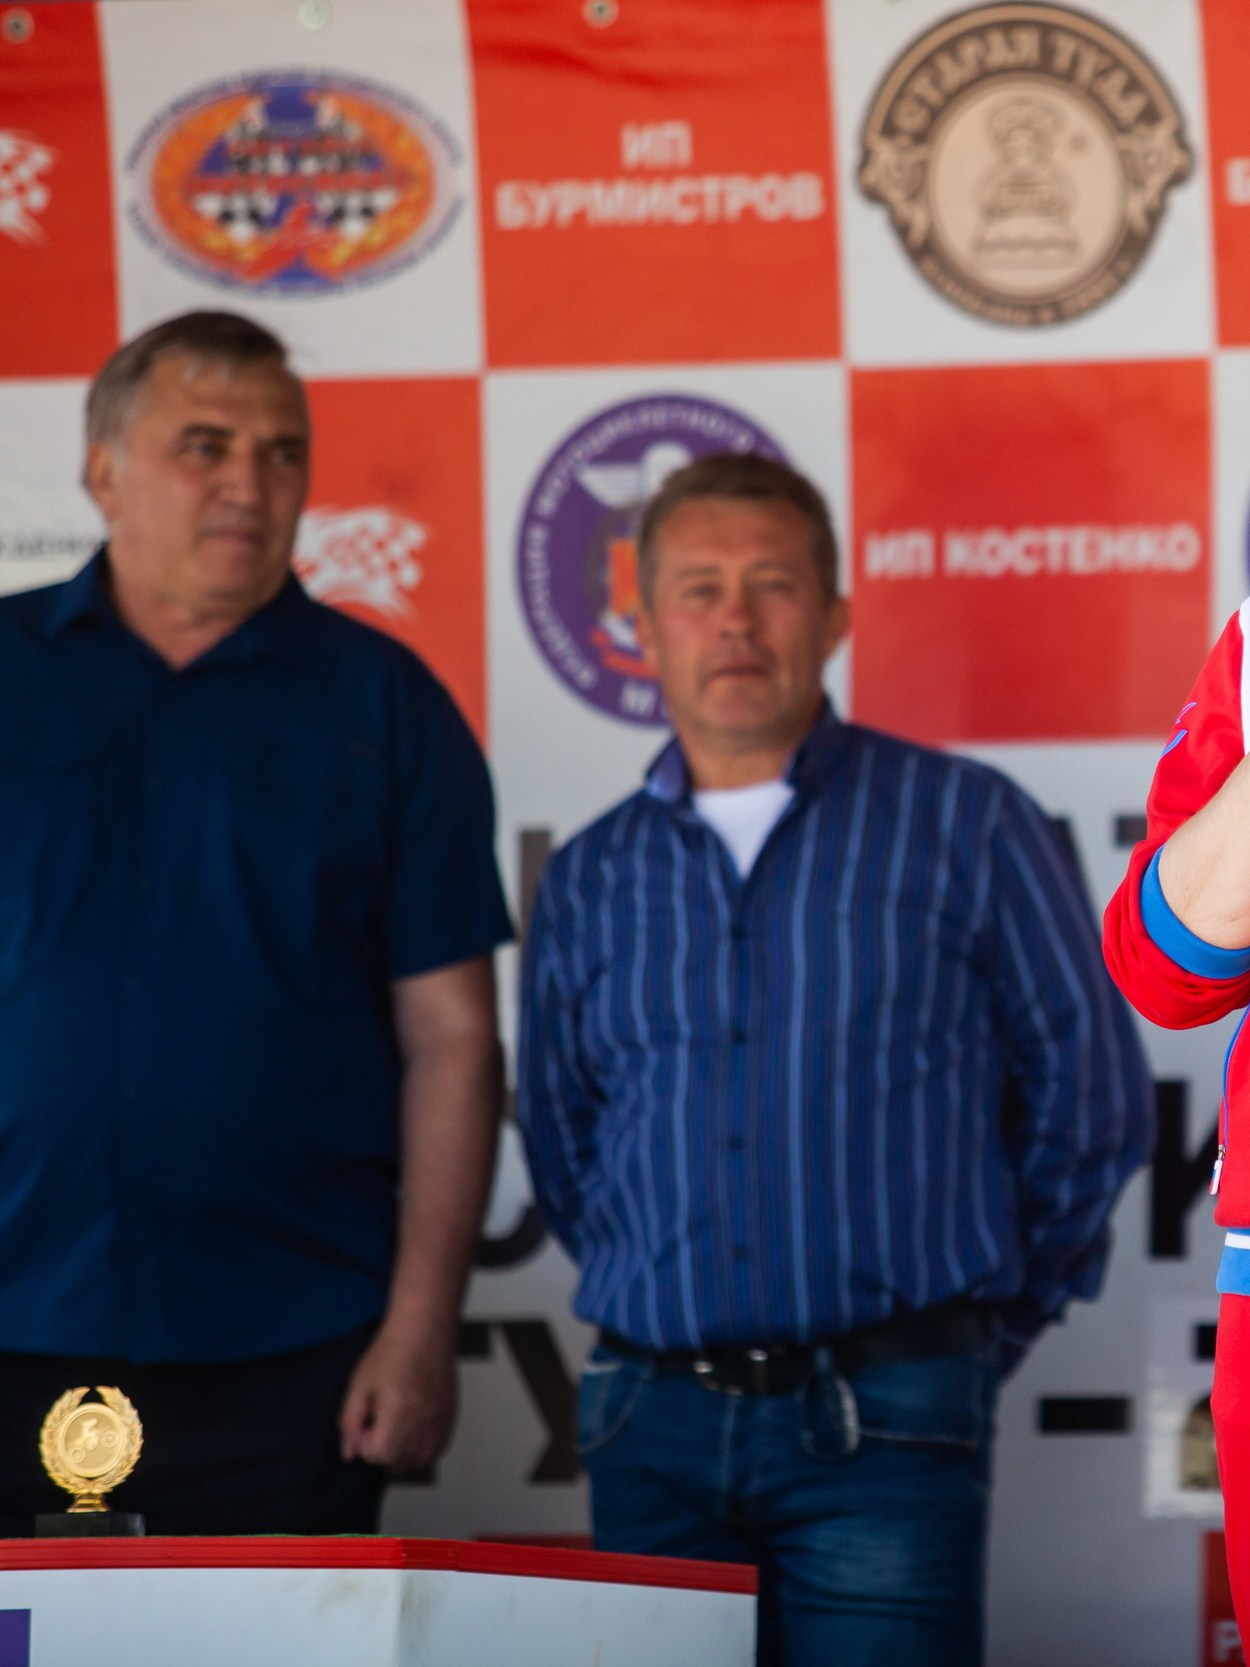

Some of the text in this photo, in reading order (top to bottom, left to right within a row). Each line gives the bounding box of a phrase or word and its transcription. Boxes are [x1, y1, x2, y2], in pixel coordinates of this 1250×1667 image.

[889, 22, 1042, 137] СТАРАЯ
[619, 120, 694, 171] ИП
[495, 172, 823, 230] БУРМИСТРОВ
[863, 521, 1200, 580] ИП КОСТЕНКО
